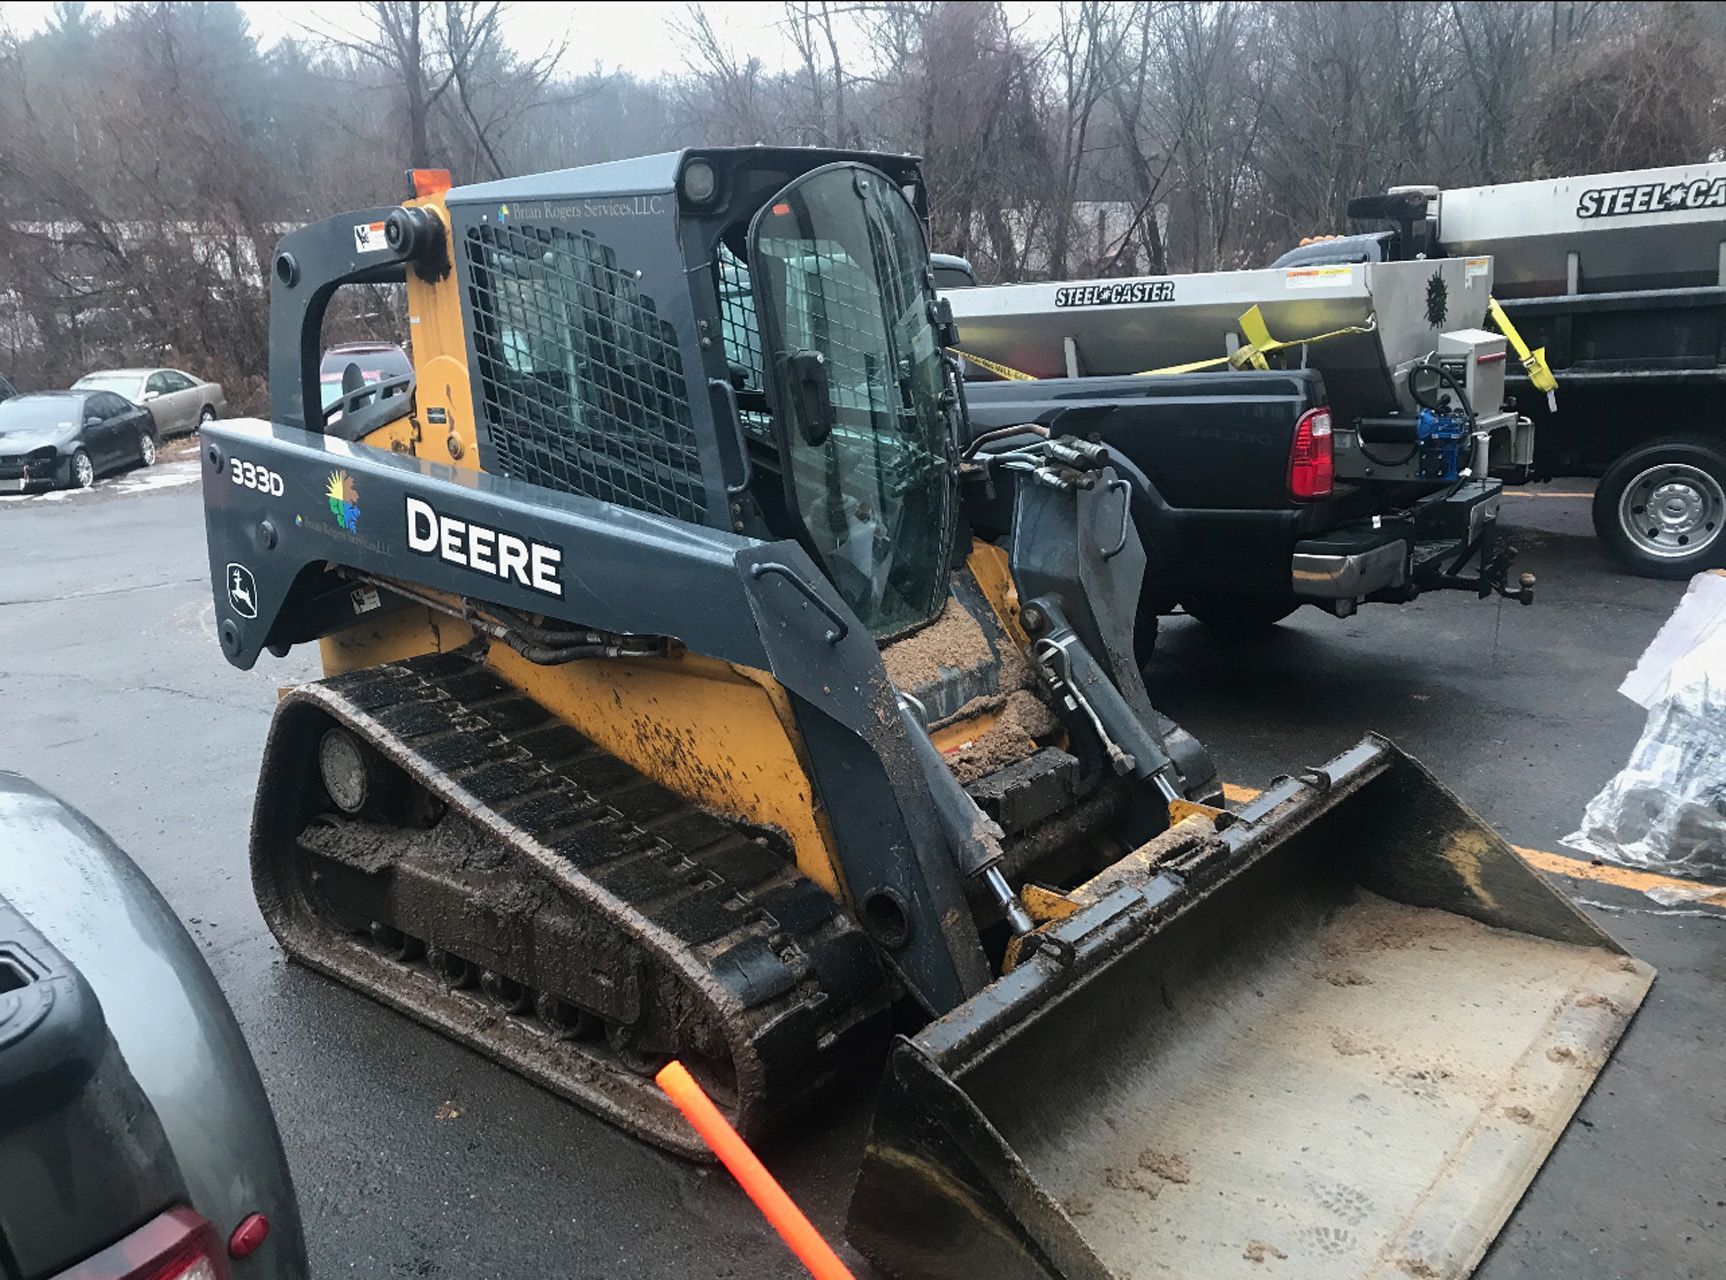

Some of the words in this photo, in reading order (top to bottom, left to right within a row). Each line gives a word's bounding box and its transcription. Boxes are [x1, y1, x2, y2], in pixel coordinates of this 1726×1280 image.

[512, 202, 542, 220] Brian
[543, 201, 582, 223] Rogers
[1577, 183, 1666, 218] STEEL
[1055, 286, 1102, 307] STEEL
[1110, 281, 1175, 304] CASTER
[230, 457, 284, 497] 333D
[406, 495, 563, 597] DEERE
